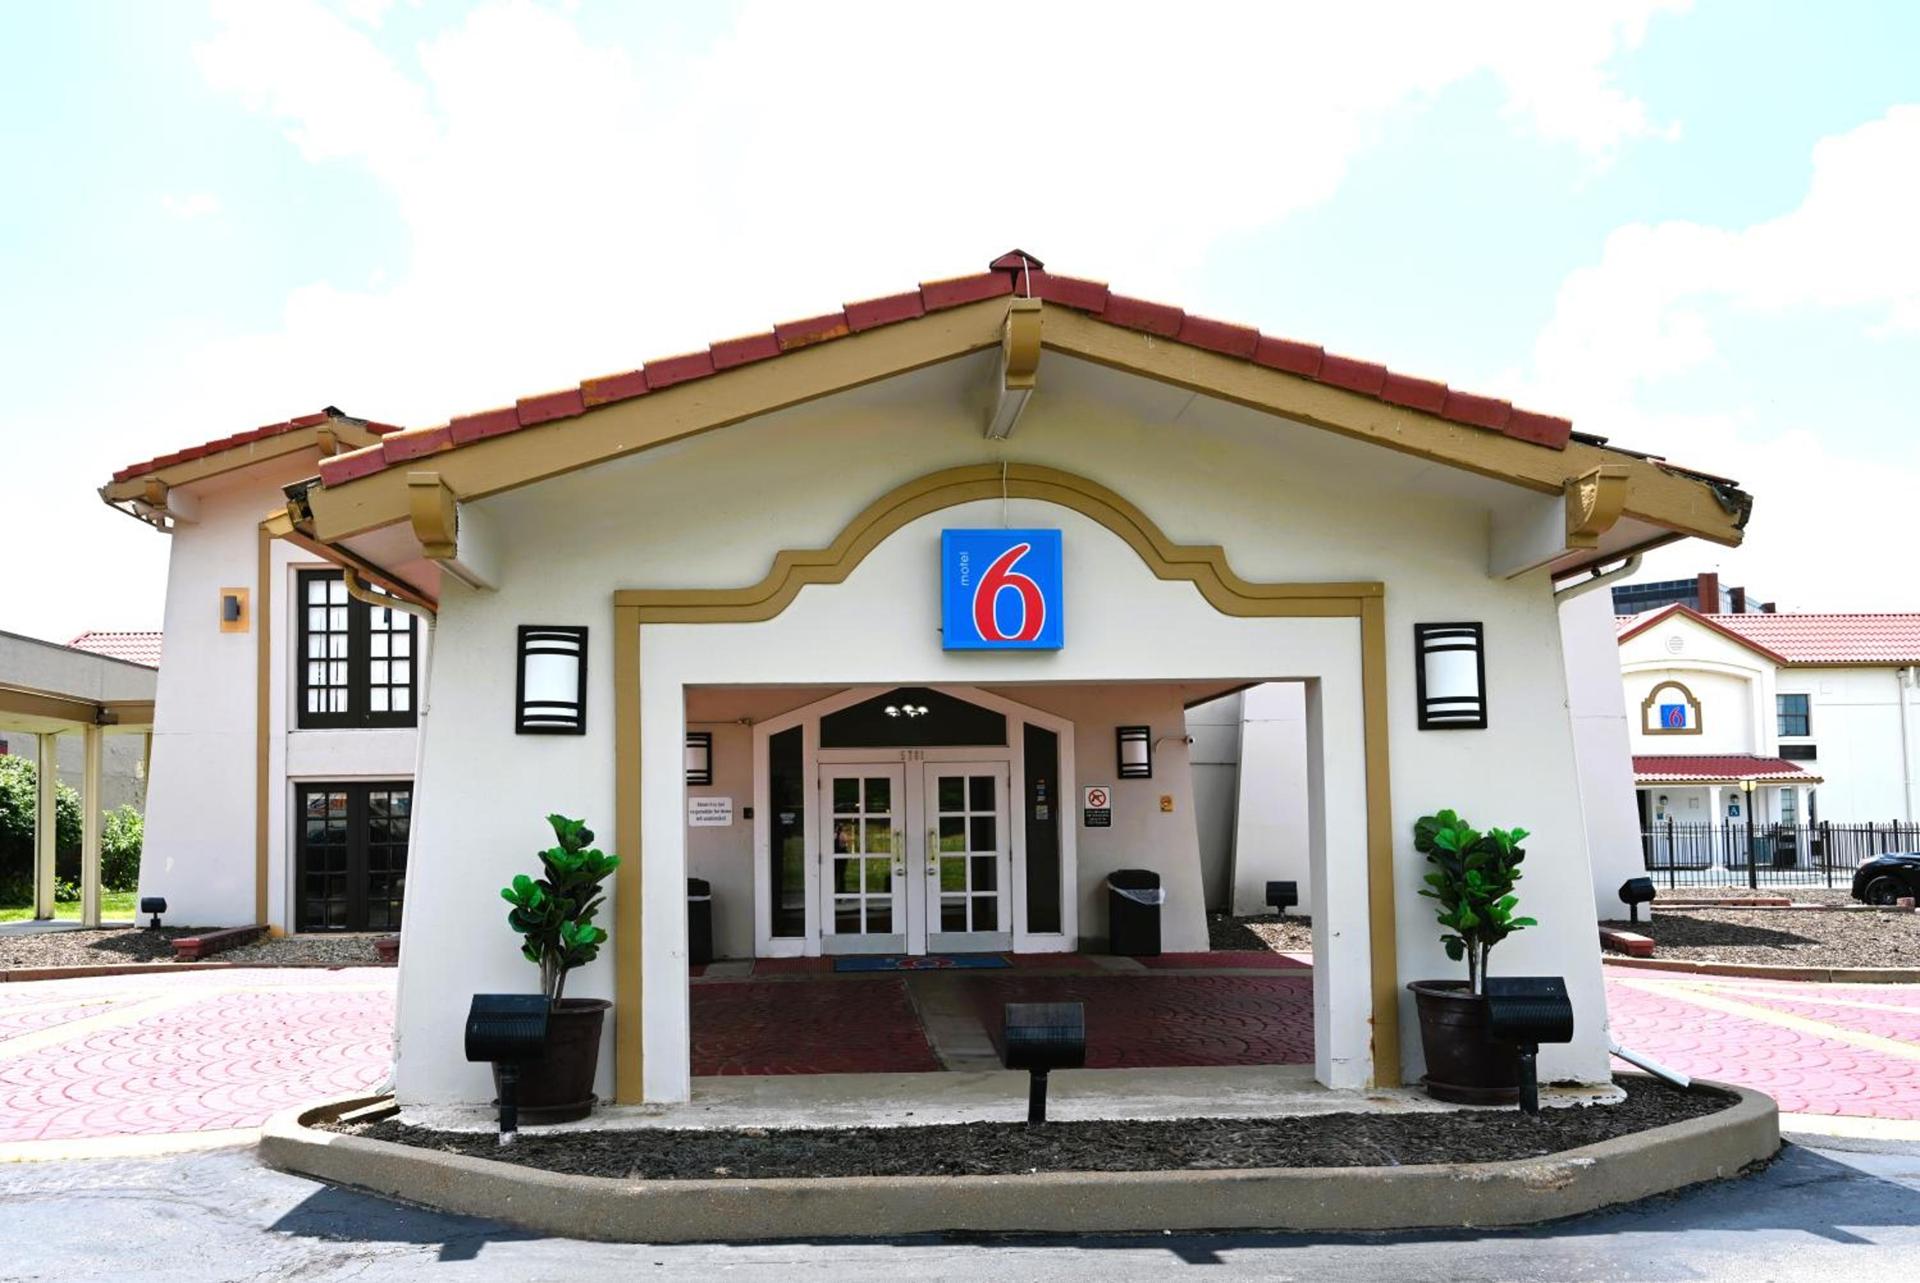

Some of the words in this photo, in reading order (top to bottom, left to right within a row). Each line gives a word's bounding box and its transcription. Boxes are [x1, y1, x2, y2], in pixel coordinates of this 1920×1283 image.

[960, 551, 970, 587] motel
[972, 542, 1047, 642] 6
[1669, 706, 1683, 728] 6
